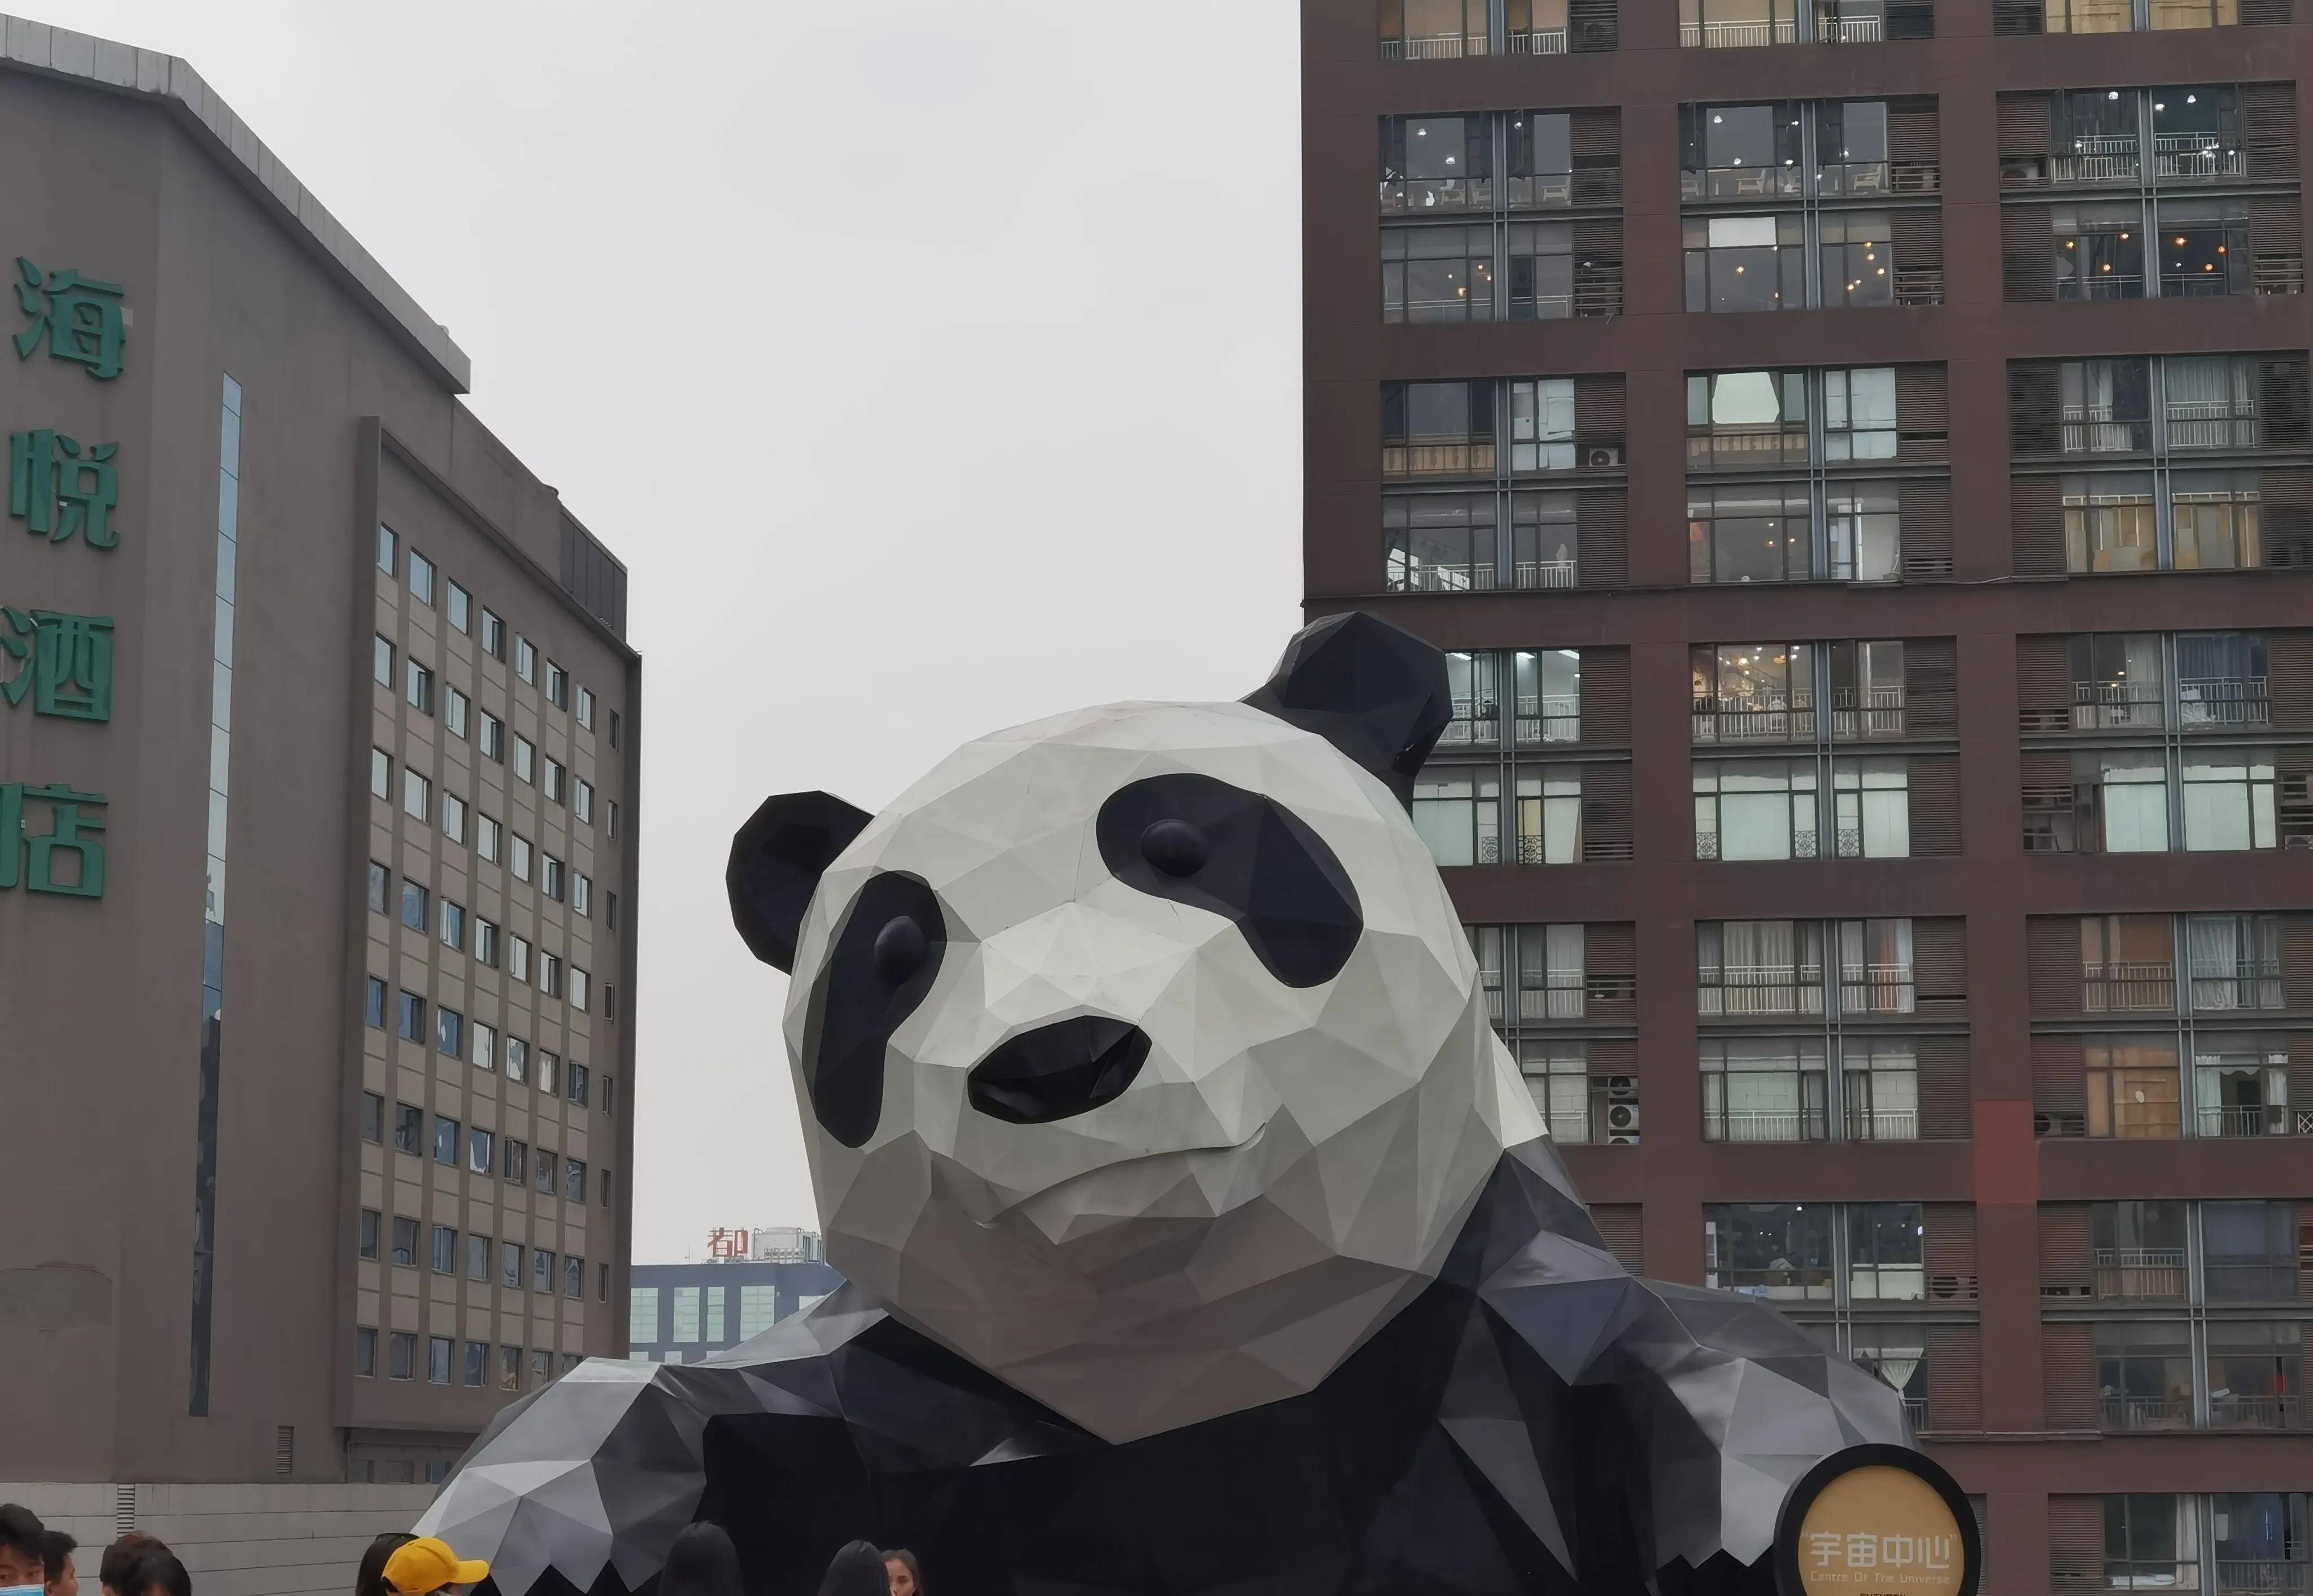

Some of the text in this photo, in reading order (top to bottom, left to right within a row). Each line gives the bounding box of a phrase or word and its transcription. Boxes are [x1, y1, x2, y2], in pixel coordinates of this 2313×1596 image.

[0, 256, 126, 897] 海悦酒店
[1810, 1571, 1952, 1585] Centre Of The Universe
